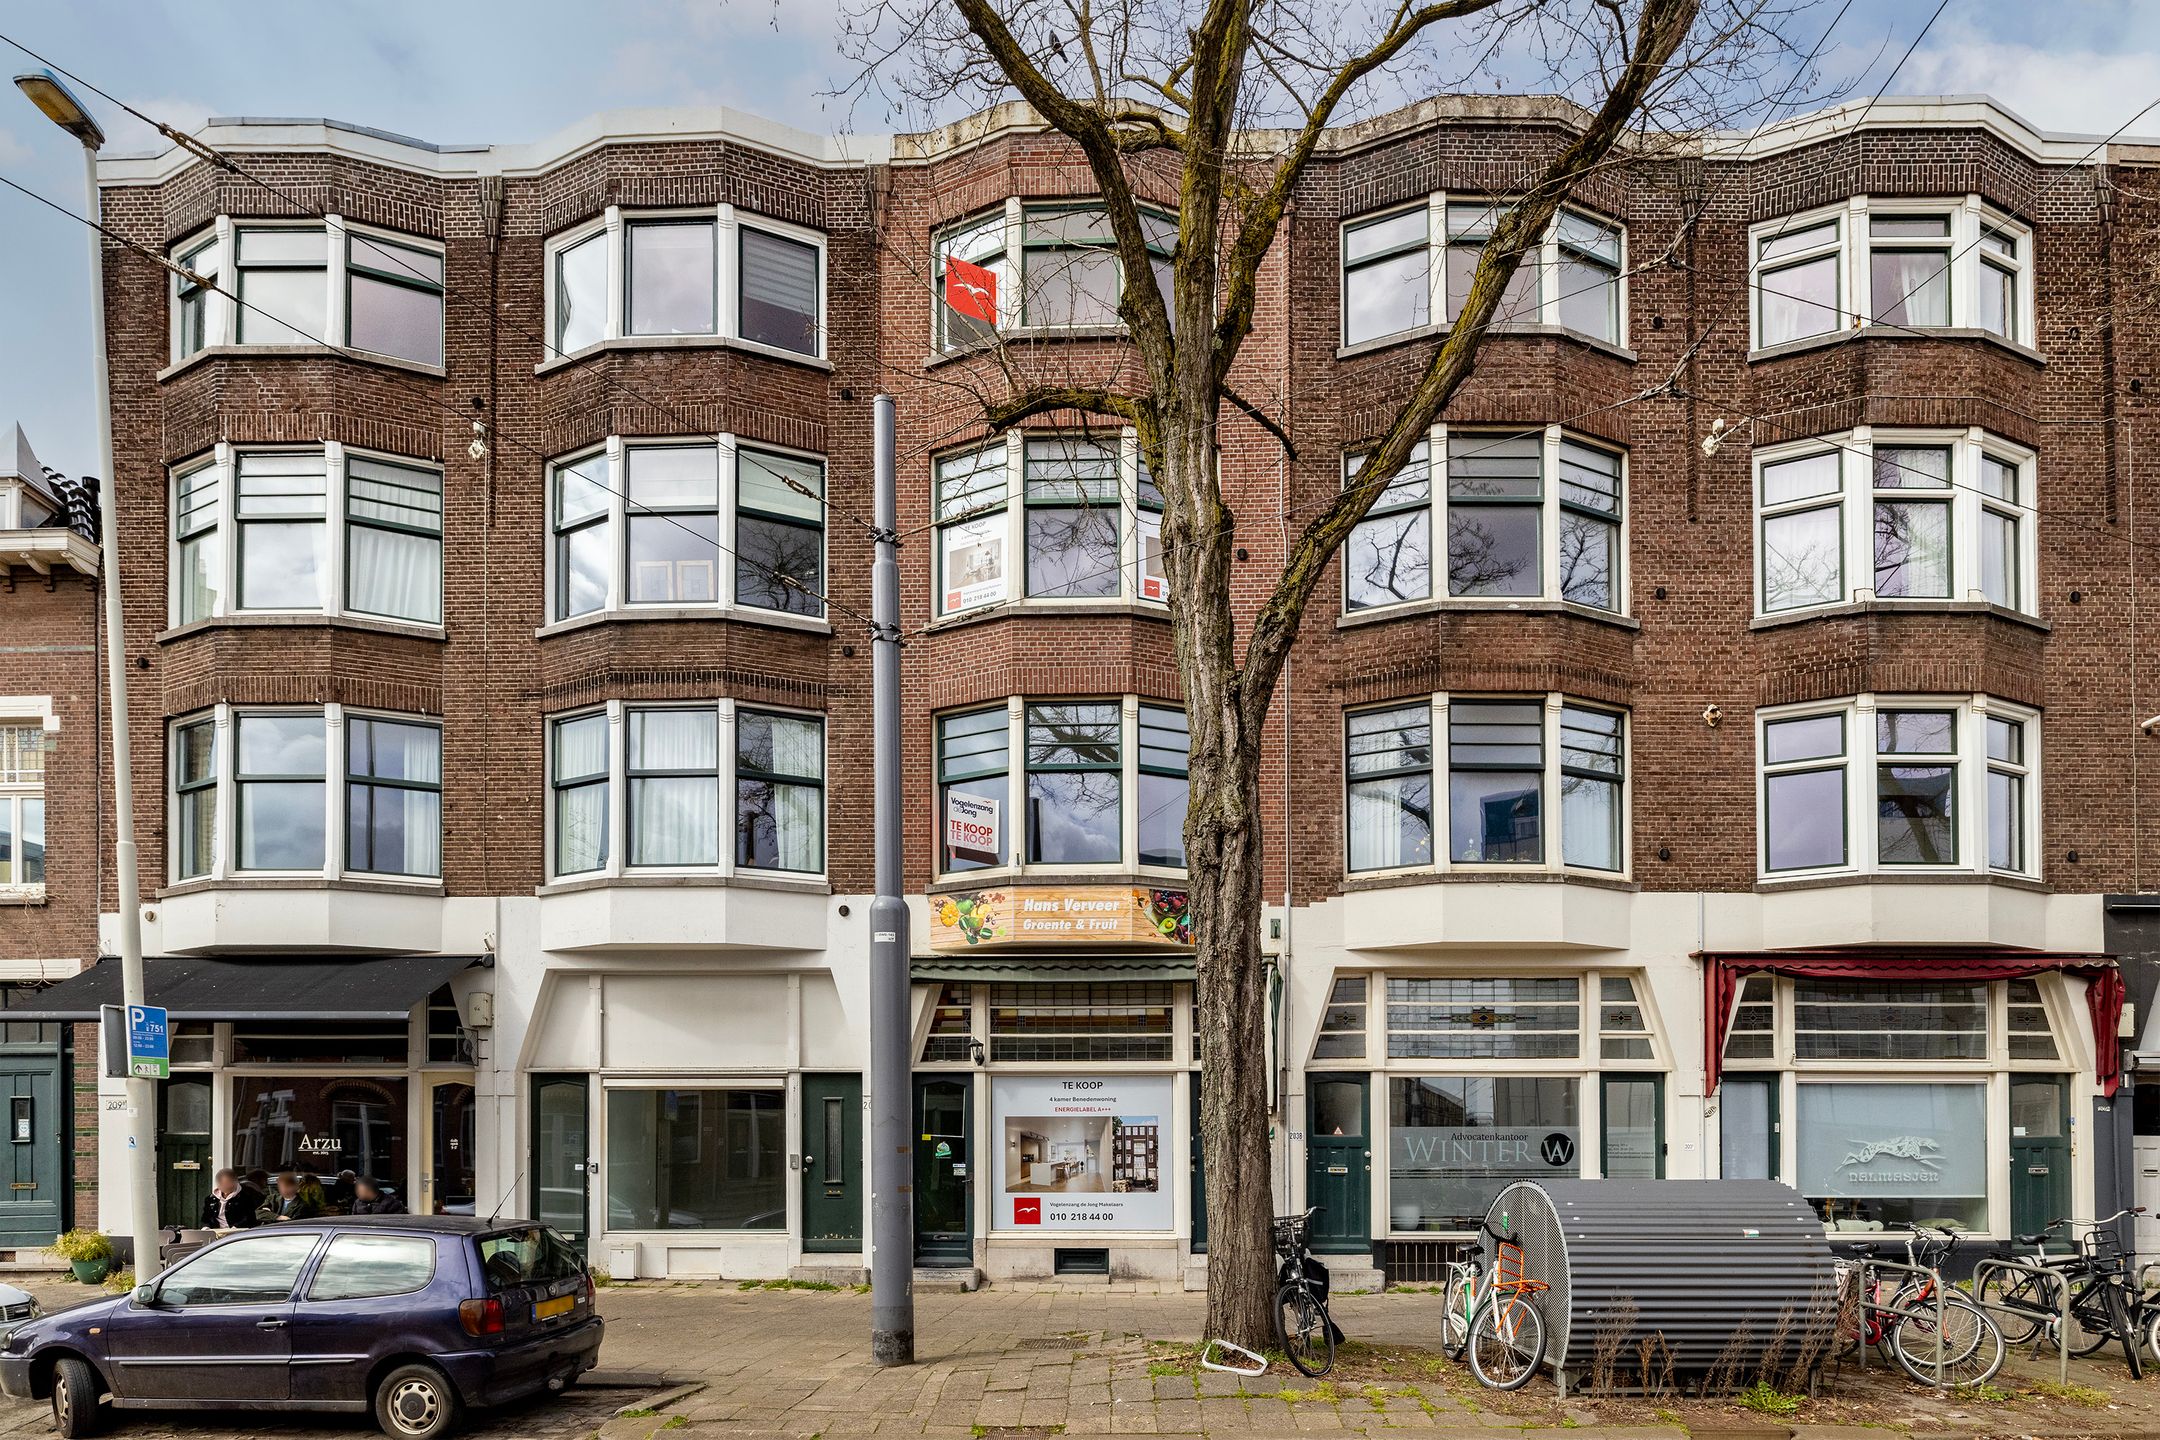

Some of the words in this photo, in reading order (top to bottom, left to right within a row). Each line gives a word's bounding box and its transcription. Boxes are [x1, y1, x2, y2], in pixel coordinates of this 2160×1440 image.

[950, 797, 993, 814] Vogelenzang
[951, 820, 961, 831] TE
[964, 823, 993, 836] KOOP
[951, 830, 961, 841] TE
[964, 833, 993, 846] KOOP
[1023, 898, 1059, 912] Hans
[1064, 898, 1120, 912] Verveer
[1023, 919, 1072, 930] Groente
[1076, 919, 1085, 930] &
[1089, 919, 1118, 930] Fruit
[131, 1007, 146, 1031] P
[150, 1024, 164, 1033] 751
[1062, 1081, 1073, 1090] TE
[1076, 1081, 1103, 1090] KOOP
[298, 1134, 342, 1150] Arzu
[1450, 1132, 1529, 1141] Advocatenkantoor
[1404, 1136, 1535, 1162] WINTER
[1050, 1212, 1067, 1221] 010
[1070, 1212, 1087, 1221] 218
[1089, 1212, 1100, 1221] 44
[1102, 1212, 1114, 1221] 00
